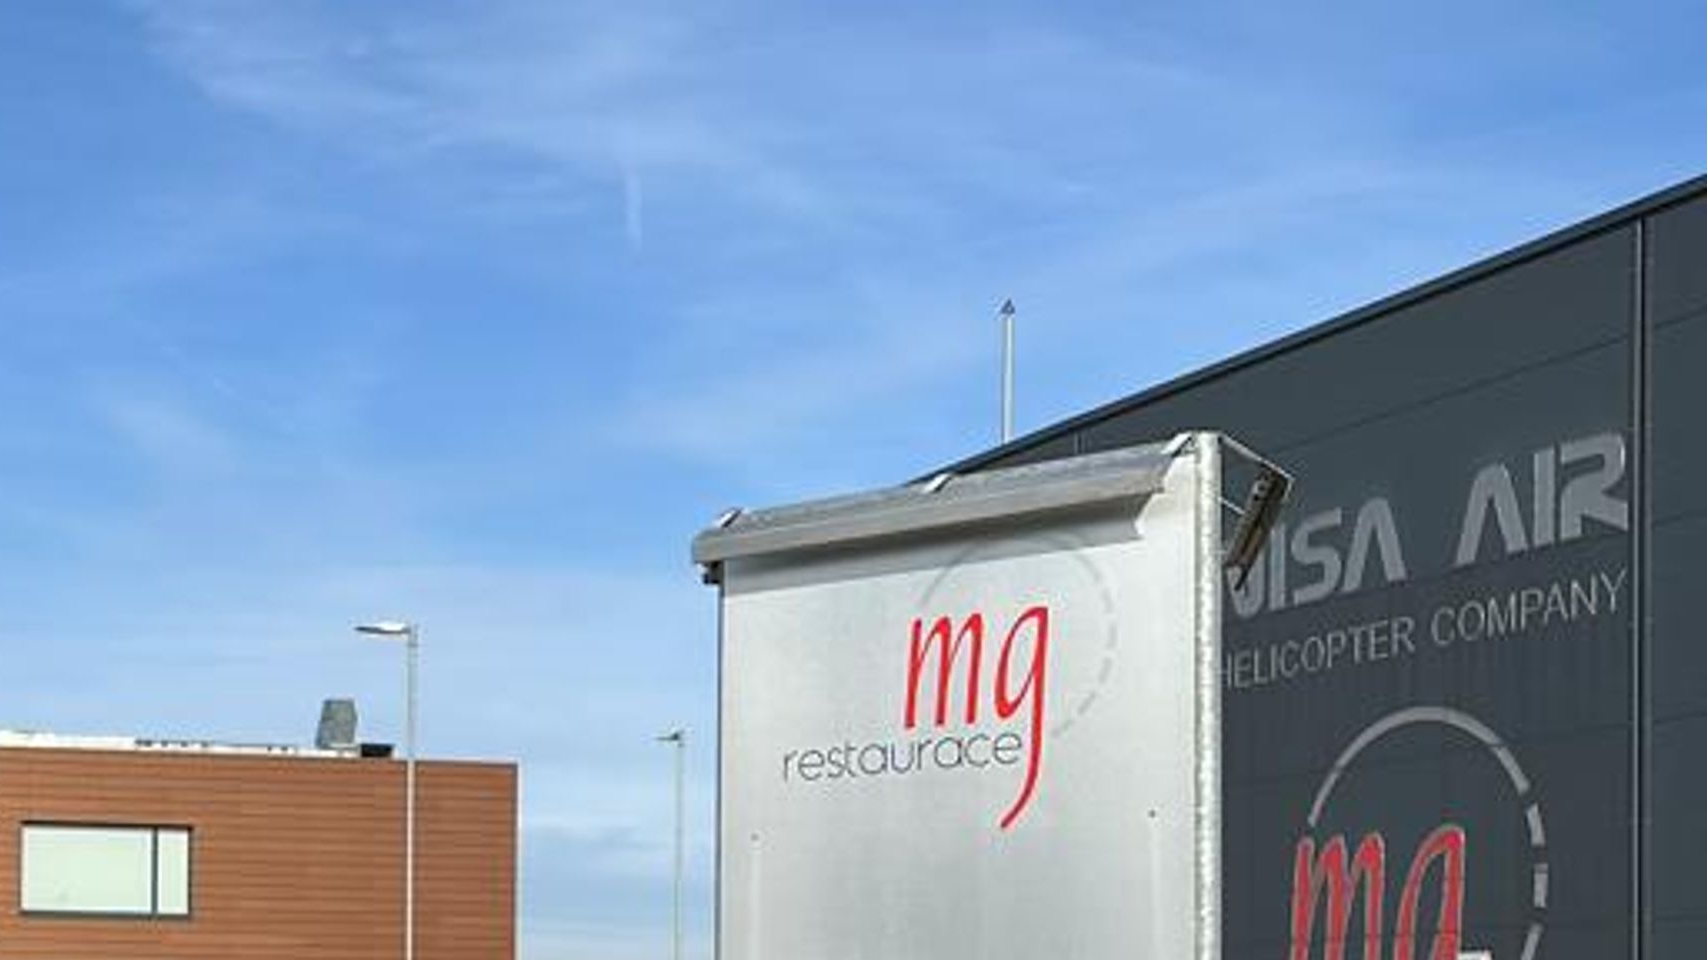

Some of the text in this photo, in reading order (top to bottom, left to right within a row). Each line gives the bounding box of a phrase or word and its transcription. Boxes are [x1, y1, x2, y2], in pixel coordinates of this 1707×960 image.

[1454, 432, 1629, 568] AIR
[1430, 567, 1628, 647] COMPANY
[782, 730, 1024, 784] restaurace
[903, 605, 1050, 830] mg
